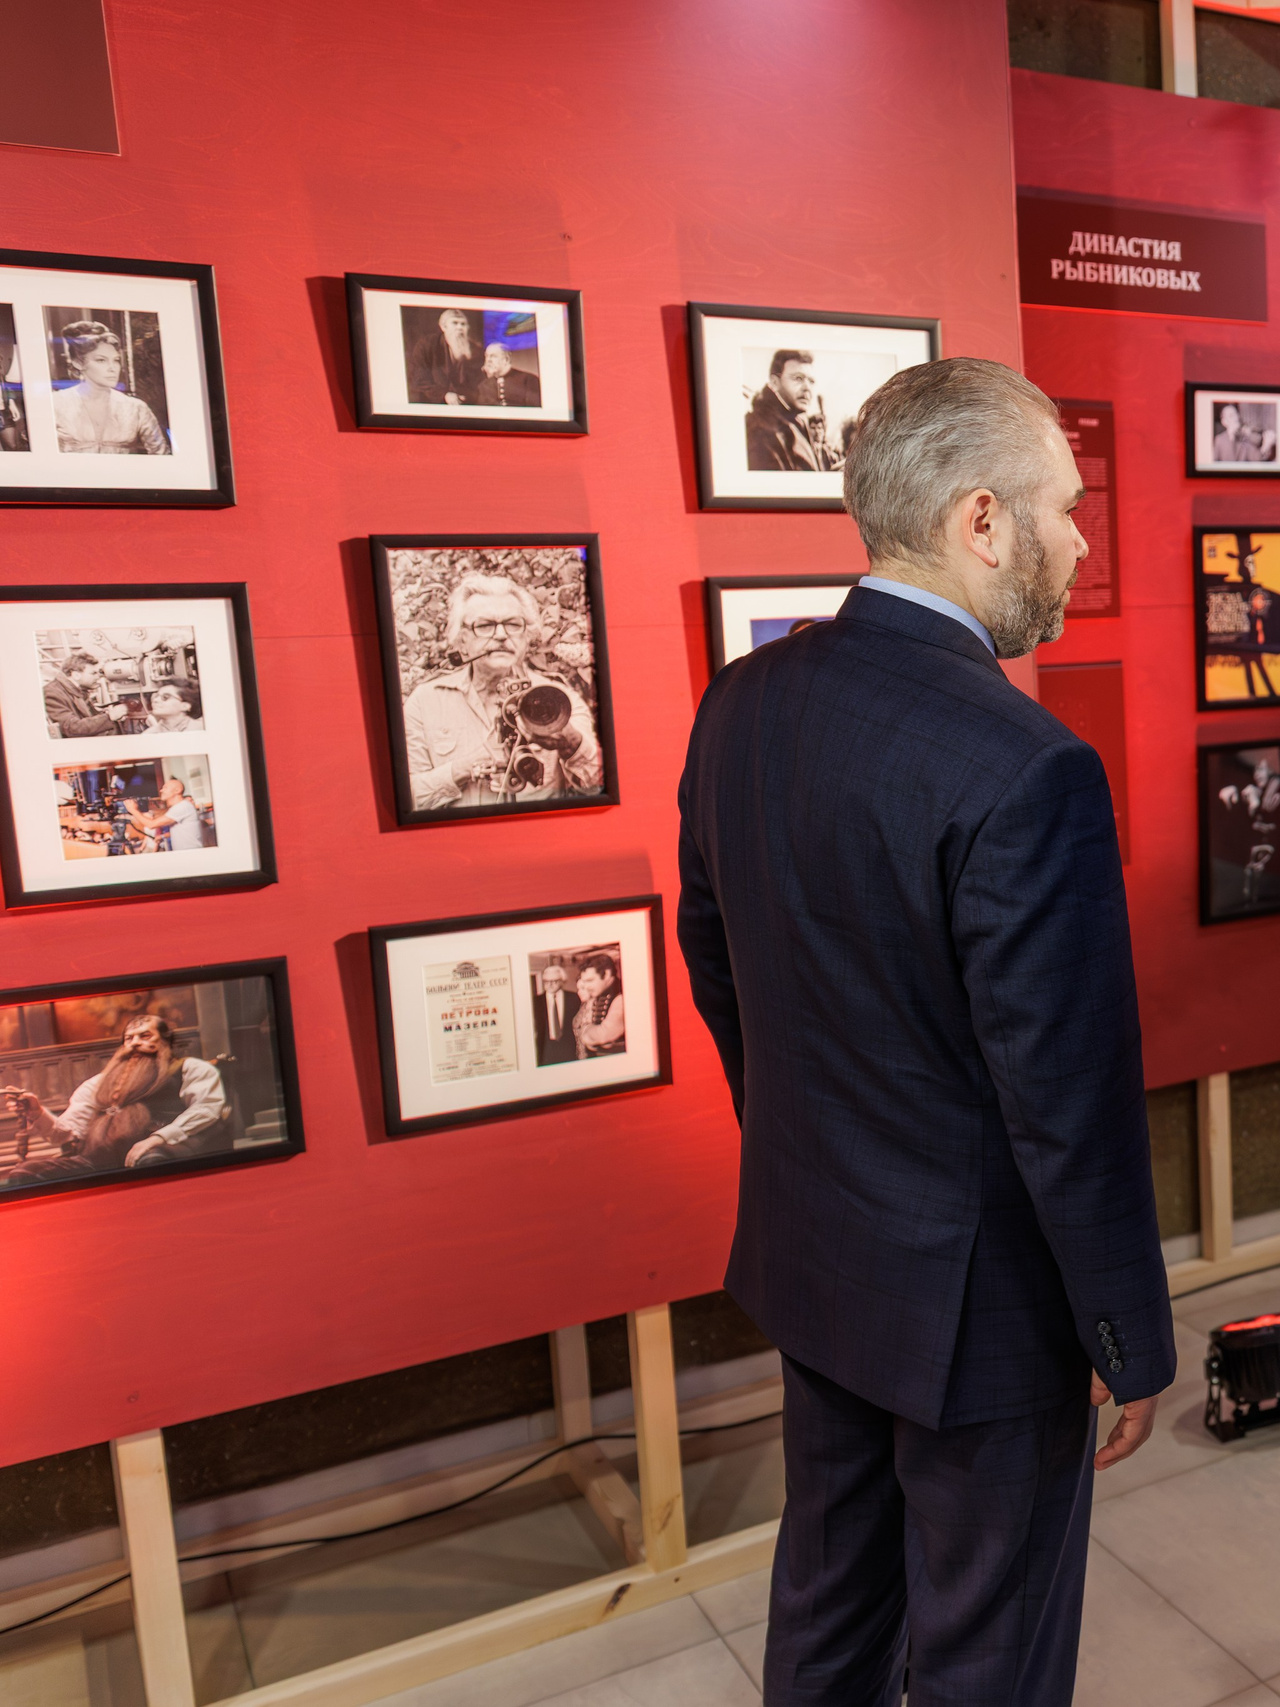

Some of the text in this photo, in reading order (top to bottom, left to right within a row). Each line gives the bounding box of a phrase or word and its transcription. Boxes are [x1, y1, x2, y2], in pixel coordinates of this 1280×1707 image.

[1069, 231, 1182, 262] ДИНАСТИЯ
[1051, 258, 1201, 292] РЫБНИКОВЫХ
[441, 1007, 498, 1020] ПЕТРОВА
[443, 1019, 497, 1033] МАЗЕПА
